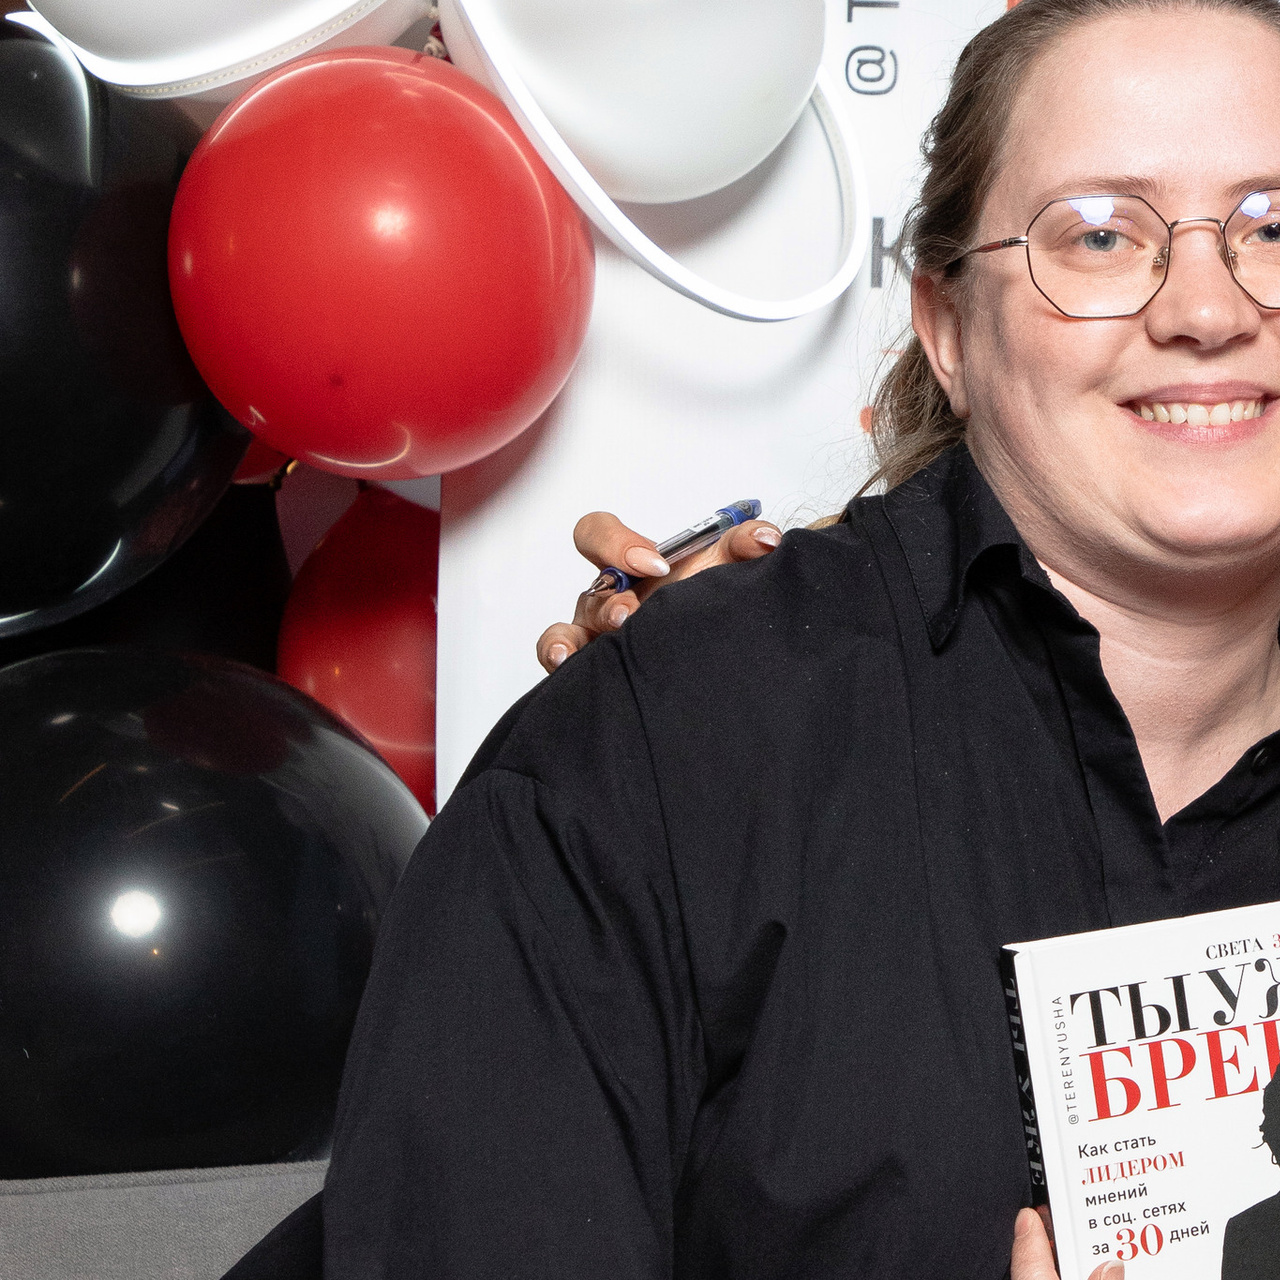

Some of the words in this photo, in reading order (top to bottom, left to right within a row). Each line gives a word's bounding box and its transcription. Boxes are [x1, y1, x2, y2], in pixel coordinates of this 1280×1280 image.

[1206, 938, 1264, 960] СВЕТА
[1070, 973, 1198, 1049] ТЫ
[1052, 996, 1079, 1125] @TERENYUSHA
[1078, 1144, 1109, 1158] Как
[1114, 1135, 1156, 1152] стать
[1081, 1151, 1187, 1185] ЛИДЕРОМ
[1085, 1183, 1148, 1207] мнений
[1089, 1217, 1097, 1229] в
[1103, 1212, 1136, 1226] соц.
[1143, 1201, 1187, 1219] сетях
[1092, 1242, 1109, 1255] за
[1116, 1223, 1164, 1261] 30
[1170, 1221, 1210, 1242] дней
